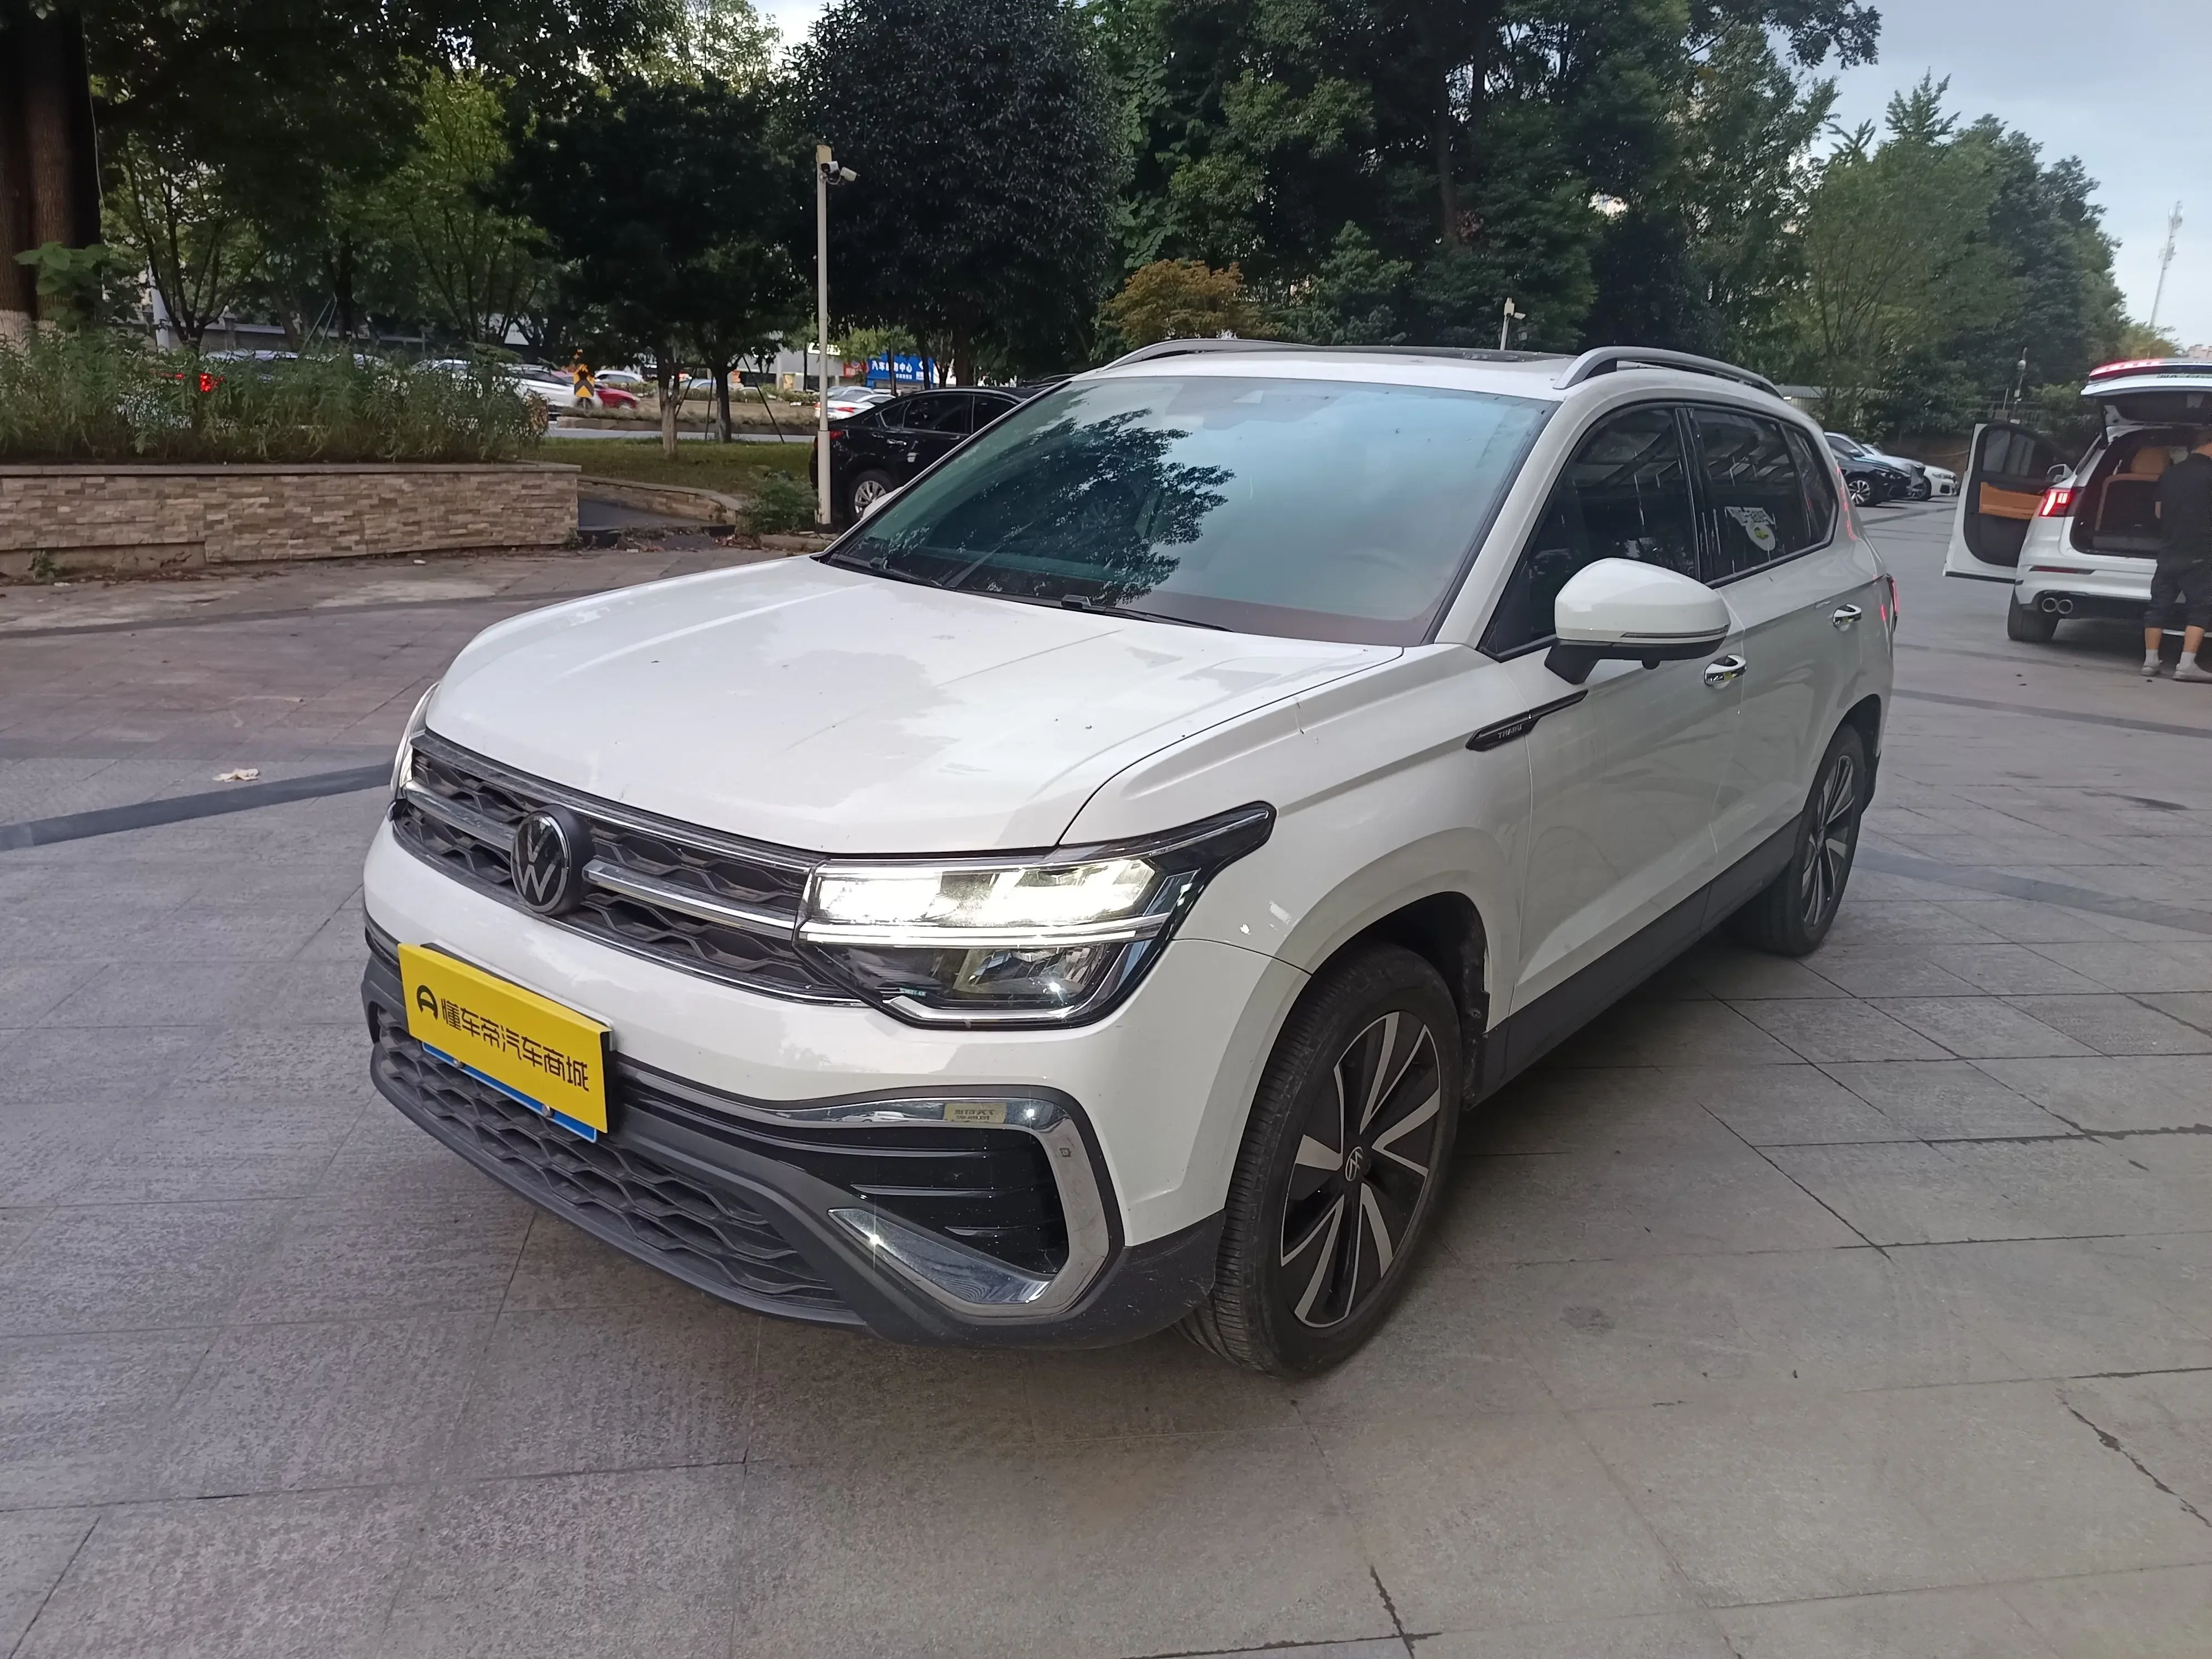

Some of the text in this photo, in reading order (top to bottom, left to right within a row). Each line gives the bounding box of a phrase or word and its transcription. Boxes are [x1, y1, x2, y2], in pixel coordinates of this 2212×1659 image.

[1498, 723, 1522, 739] THARU
[441, 998, 589, 1092] 懂车帝汽车商城
